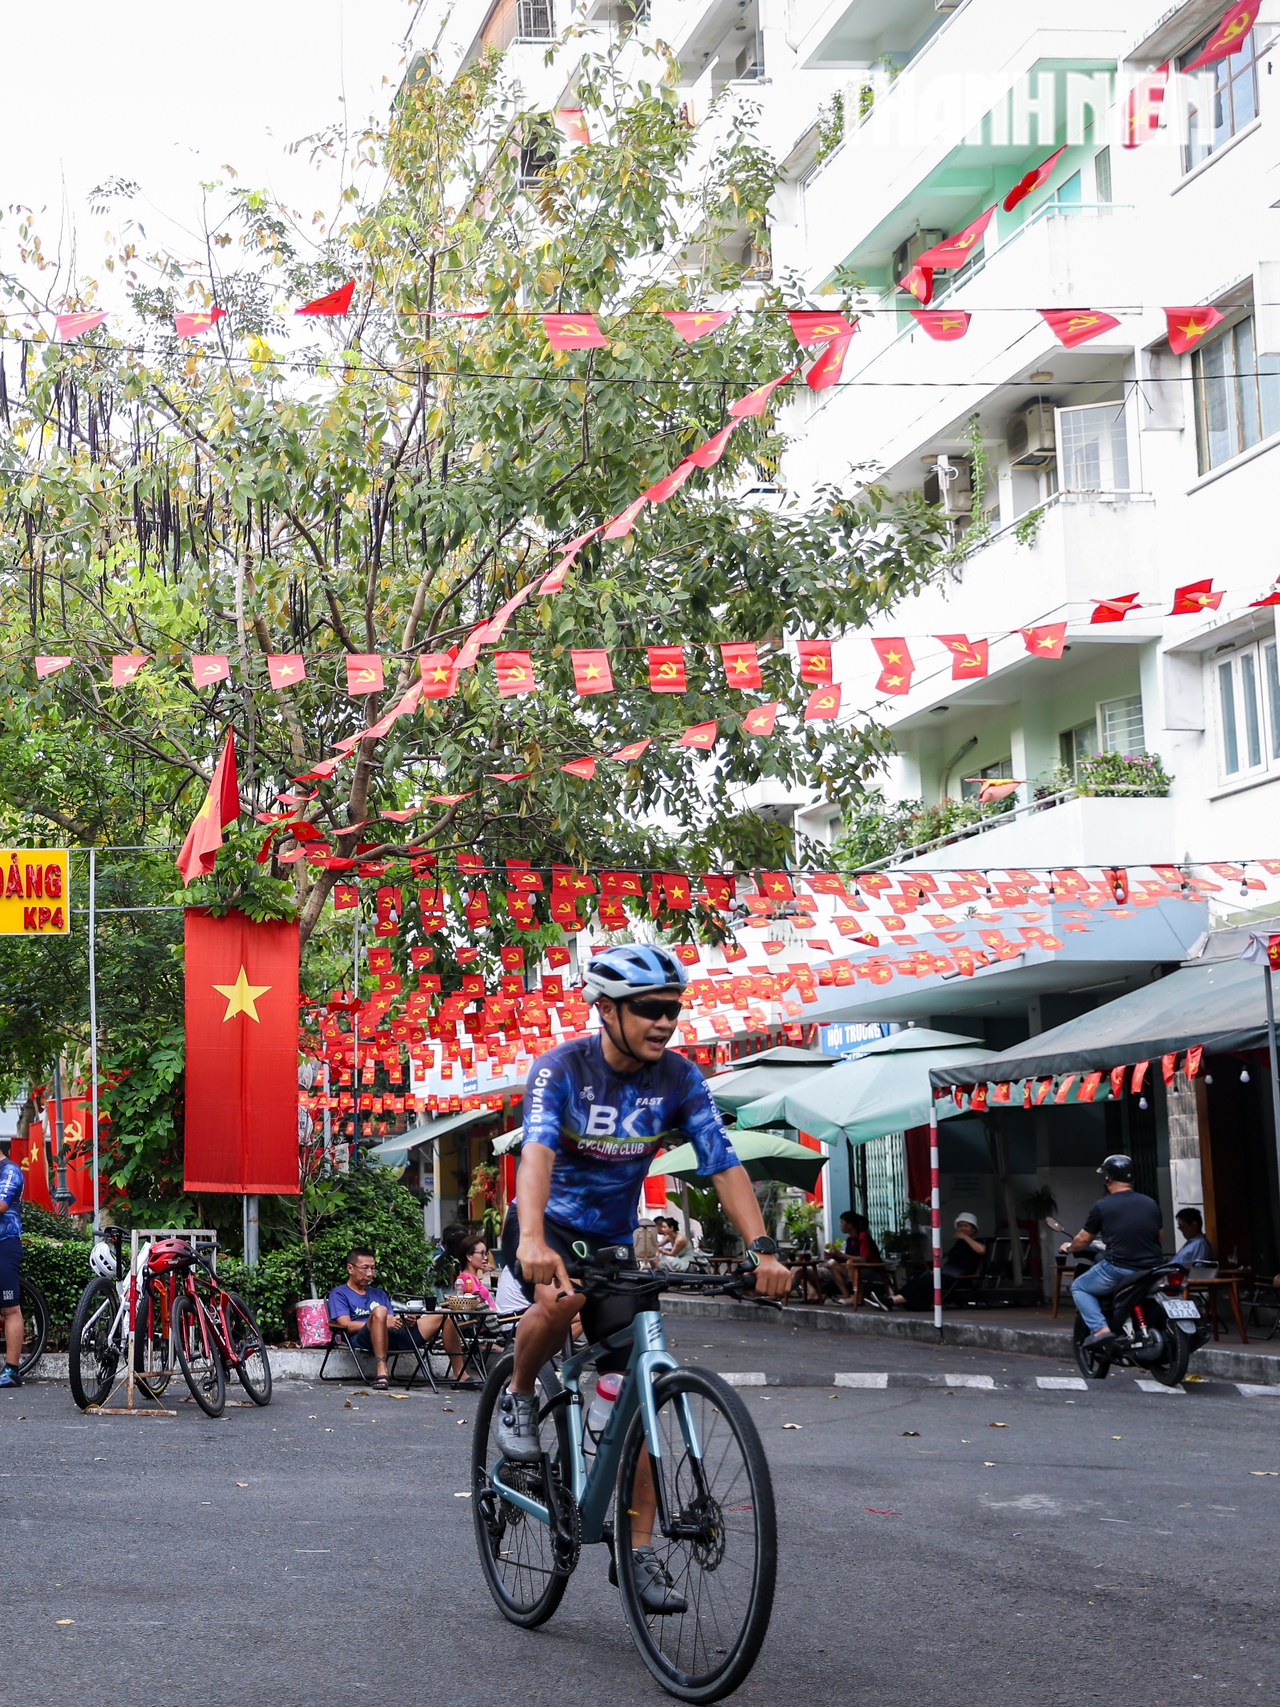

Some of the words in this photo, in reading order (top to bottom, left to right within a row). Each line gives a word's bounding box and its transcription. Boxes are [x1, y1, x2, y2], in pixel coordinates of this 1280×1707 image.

[23, 906, 64, 930] KP4
[827, 1024, 842, 1050] HỘI
[635, 1097, 663, 1106] FAST
[577, 1139, 618, 1155] CYCLING
[620, 1142, 644, 1155] CLUB
